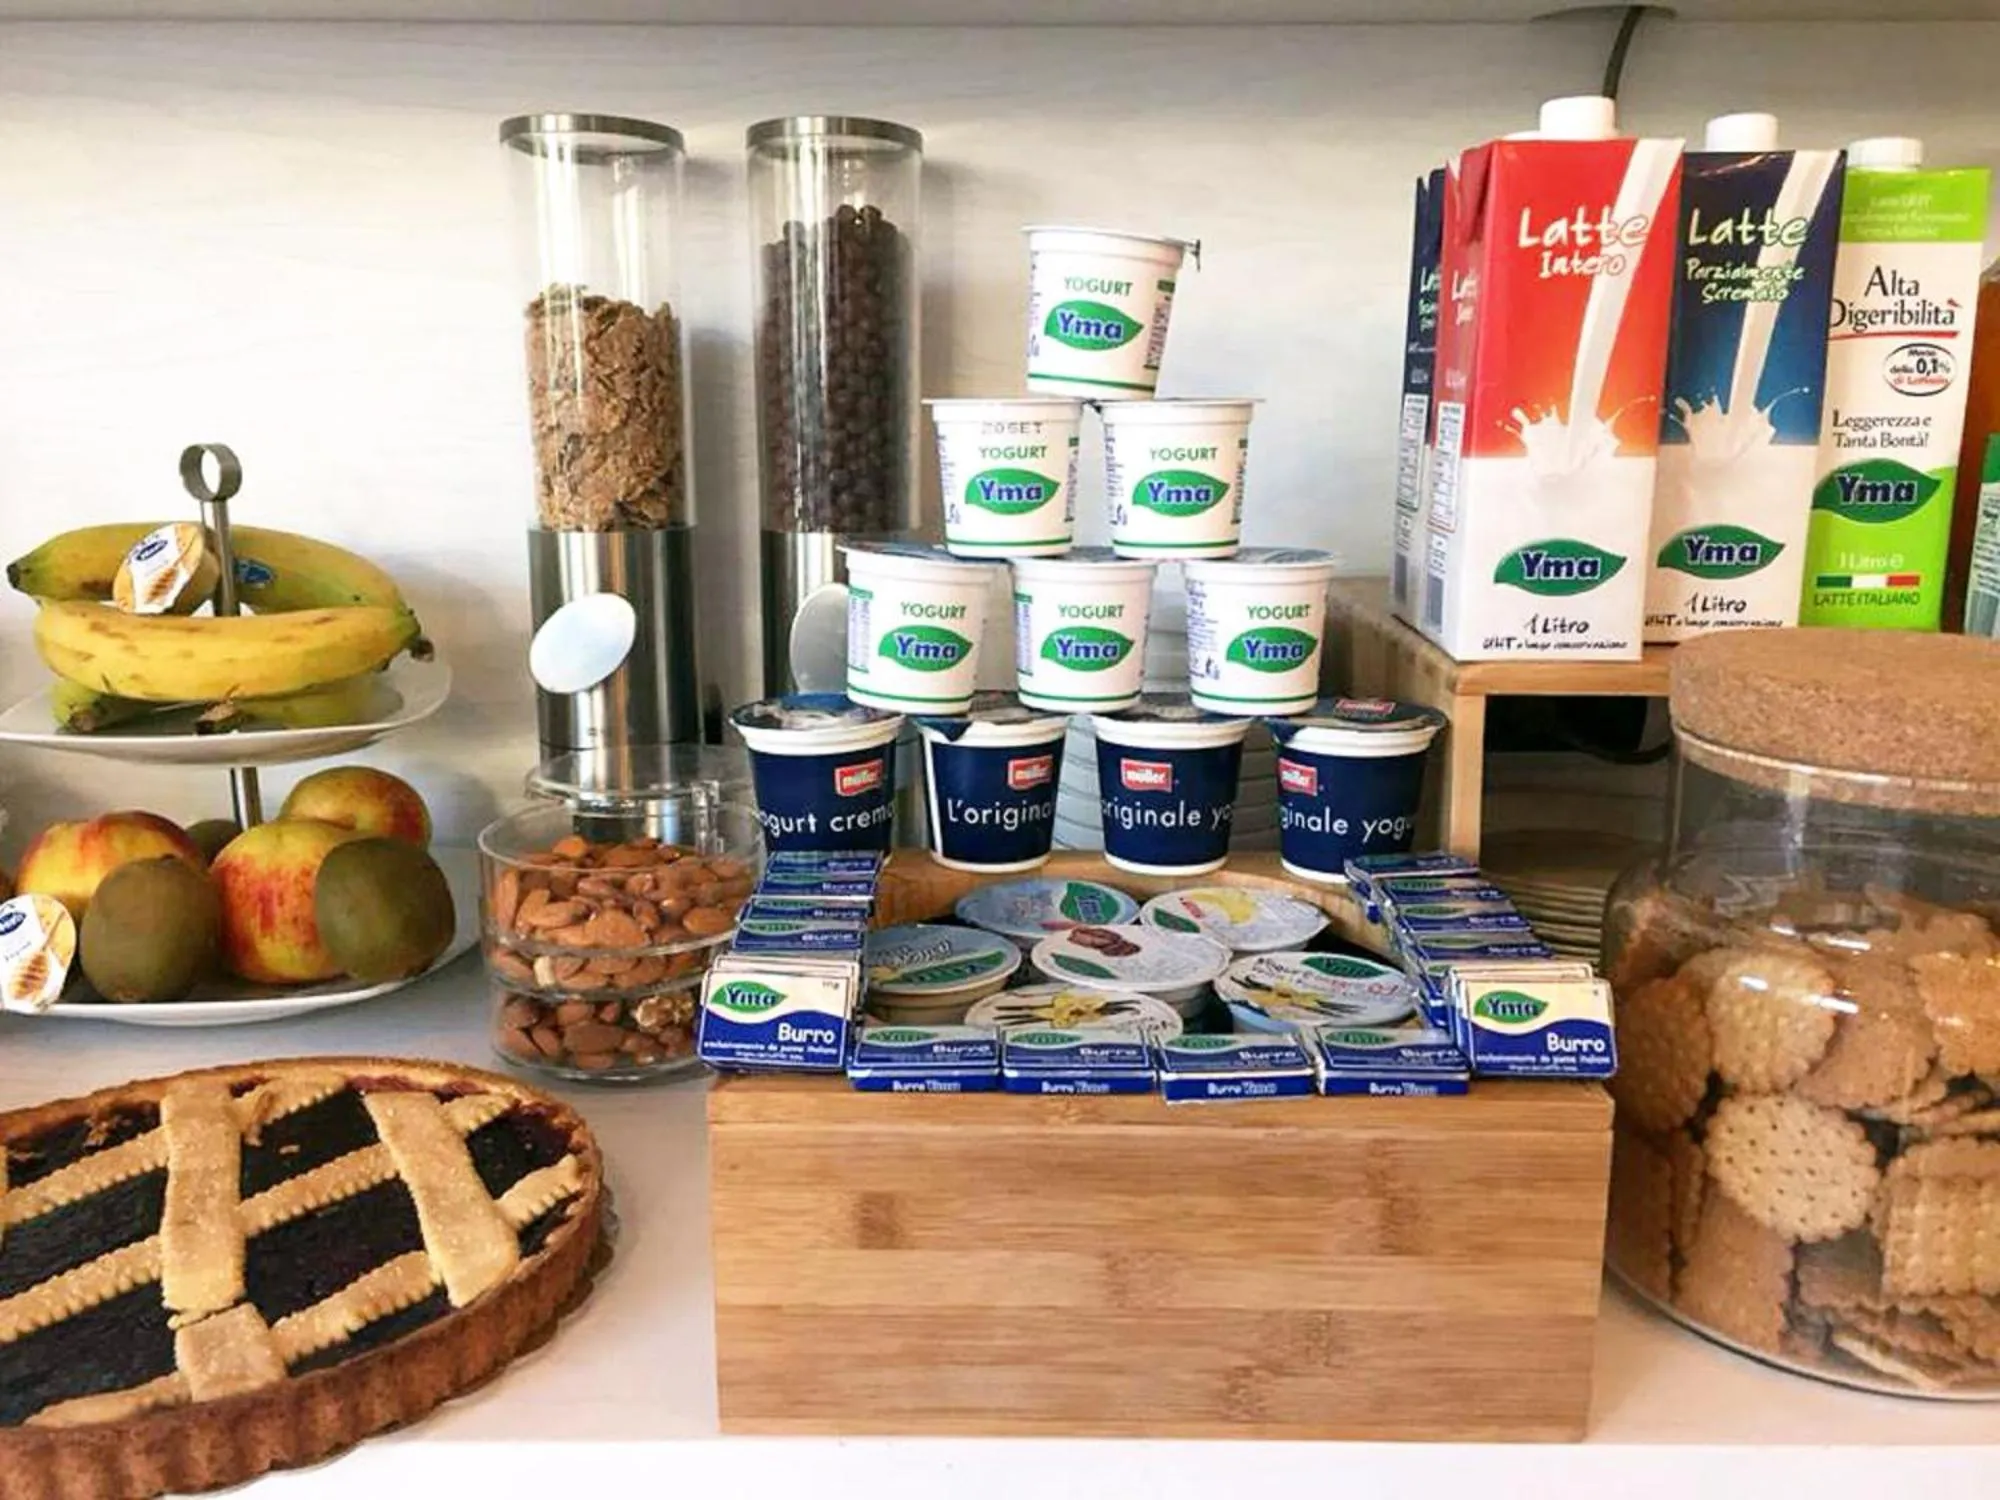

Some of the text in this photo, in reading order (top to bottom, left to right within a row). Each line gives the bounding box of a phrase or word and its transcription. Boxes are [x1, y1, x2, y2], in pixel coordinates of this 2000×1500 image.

[1517, 204, 1649, 249] Latte
[1688, 206, 1807, 247] Latte
[1538, 251, 1626, 280] Intero
[1686, 256, 1805, 280] Parzialmente
[1064, 276, 1133, 297] YOGURT
[1701, 281, 1790, 304] Scremato
[1864, 265, 1920, 297] Alta
[1059, 310, 1123, 341] Yma
[1832, 408, 1932, 432] Leggerezza e
[1832, 431, 1930, 448] Tanta Bontà!
[978, 445, 1048, 459] YOGURT
[1150, 447, 1218, 461] YOGURT
[977, 477, 1044, 502] Yma
[1145, 480, 1213, 505] Yma
[1835, 473, 1919, 505] Yma
[1684, 534, 1761, 566] Yma
[1519, 549, 1602, 581] Yma
[900, 602, 966, 619] YOGURT
[1058, 604, 1124, 619] YOGURT
[1247, 604, 1311, 620] YOGURT
[1684, 592, 1747, 613] 1 Litro
[1524, 613, 1590, 634] 1 Litro
[895, 633, 957, 659] Yma
[1055, 636, 1119, 660] Yma
[1243, 636, 1305, 660] Yma
[724, 983, 777, 1008] Yma
[1487, 998, 1537, 1017] Yma
[777, 1023, 835, 1044] Burro
[1547, 1032, 1606, 1053] Burro
